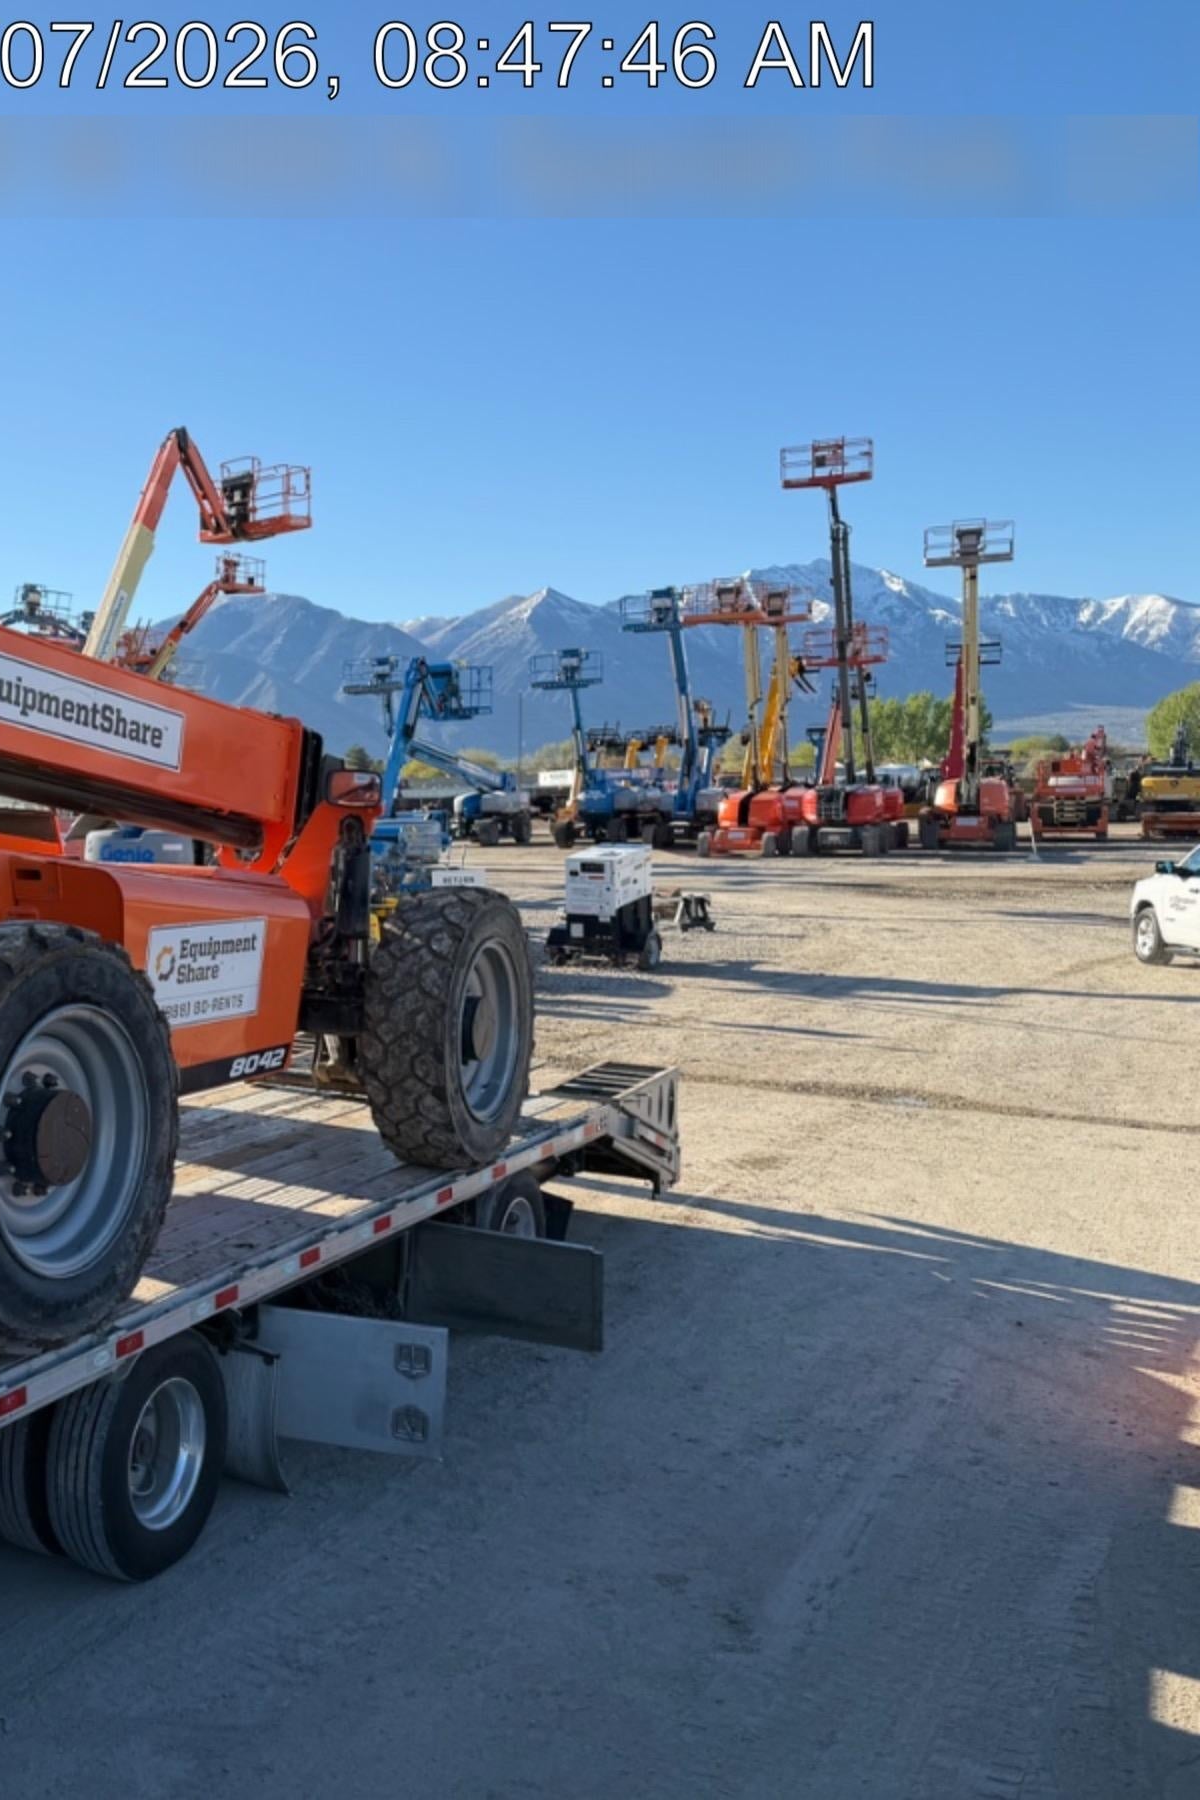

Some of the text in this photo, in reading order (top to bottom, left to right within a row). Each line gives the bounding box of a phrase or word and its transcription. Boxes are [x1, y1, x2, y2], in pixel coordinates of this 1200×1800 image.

[101, 843, 155, 863] Genie
[179, 933, 257, 963] Equipment
[176, 964, 220, 985] Share
[229, 1048, 286, 1079] 8042
